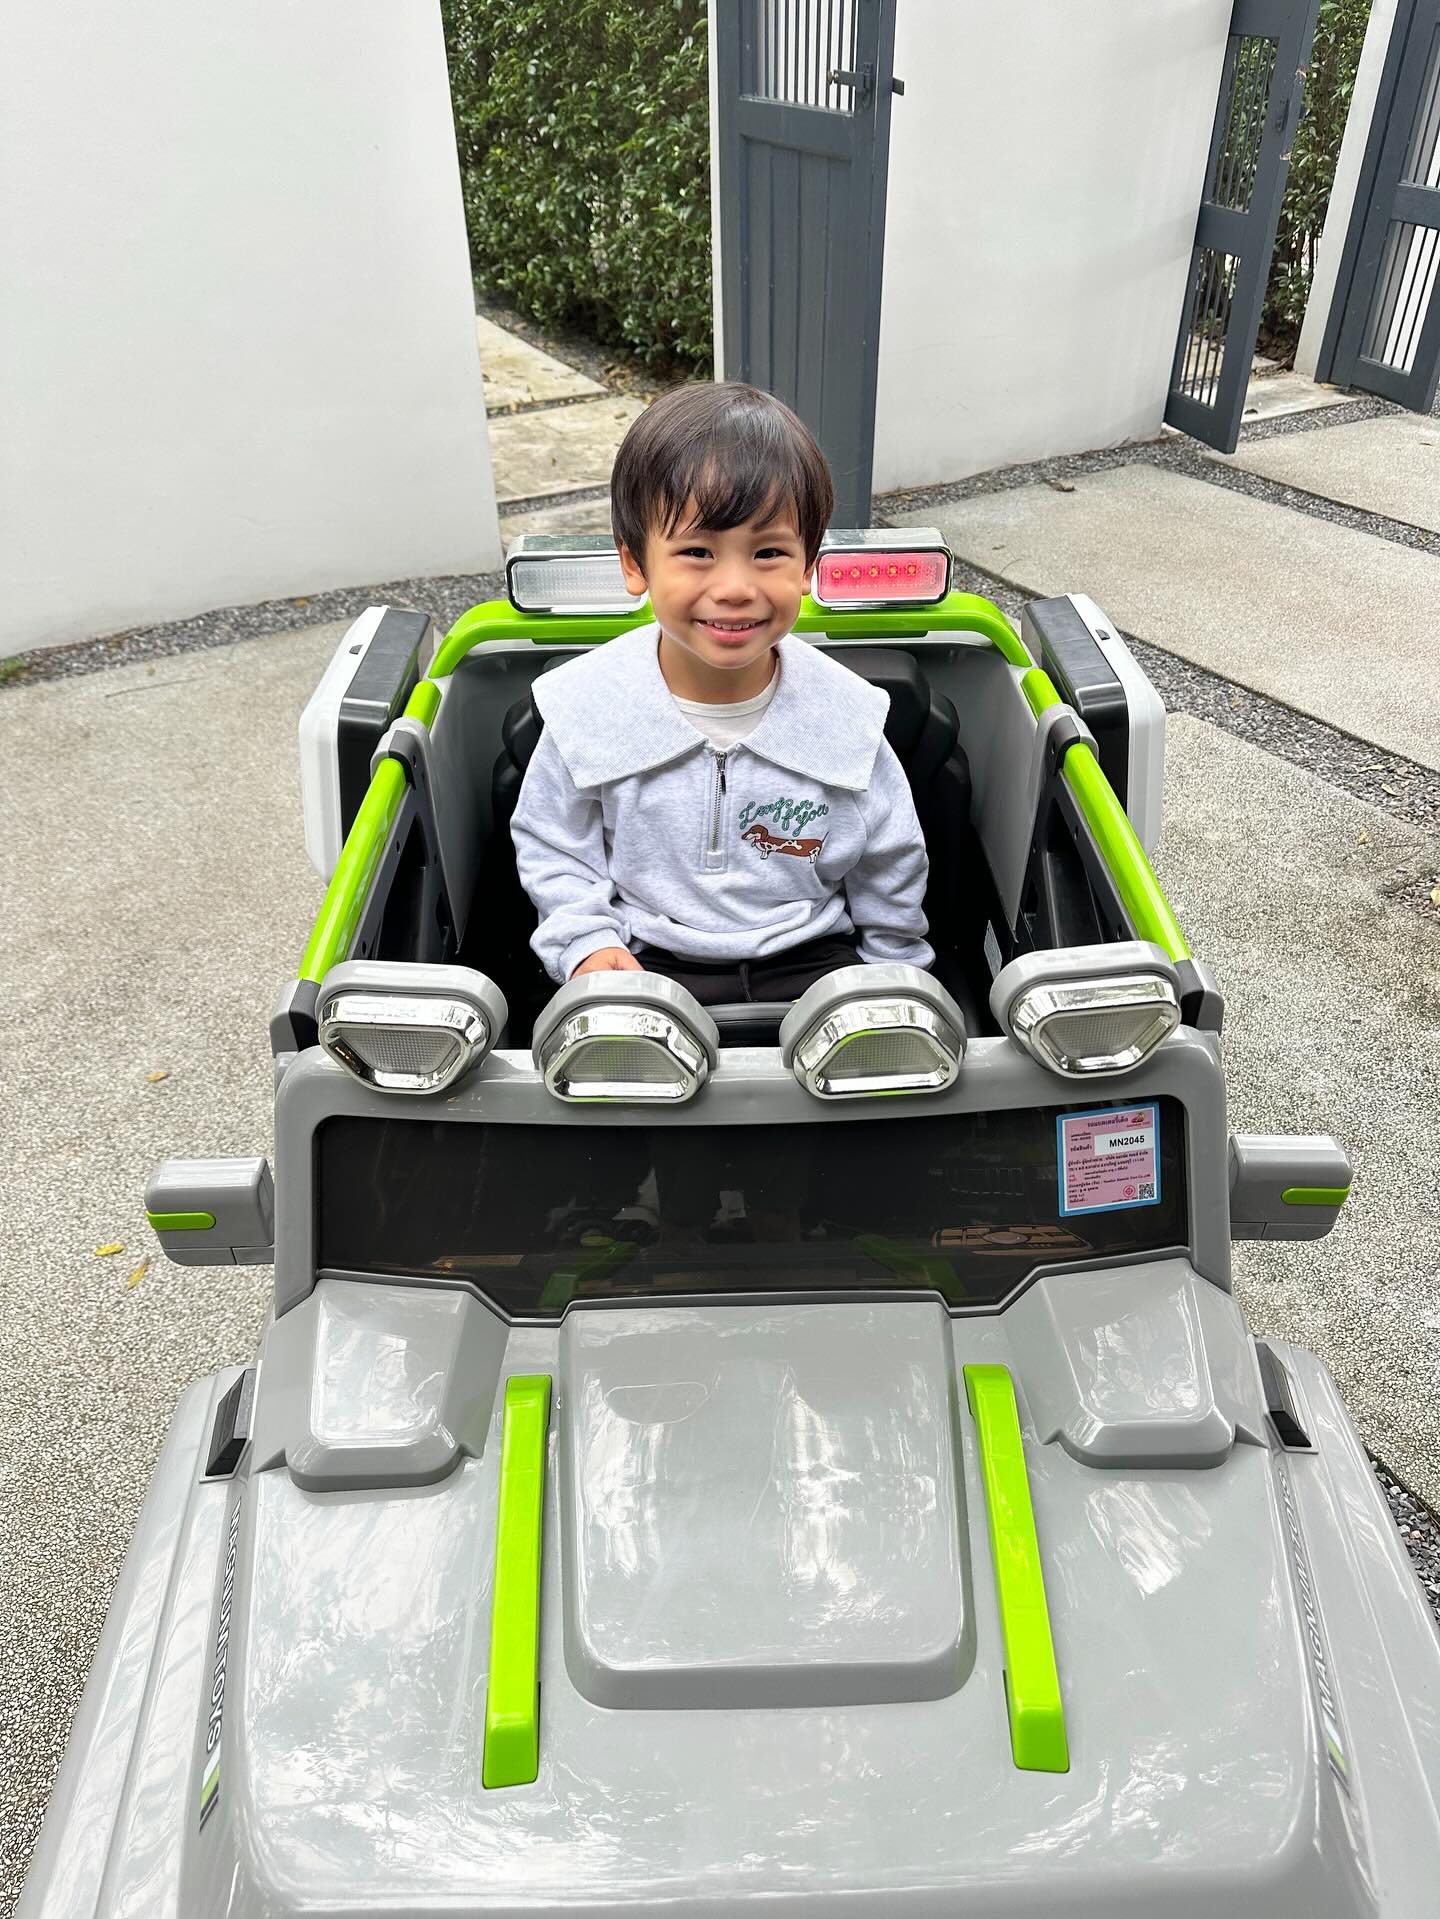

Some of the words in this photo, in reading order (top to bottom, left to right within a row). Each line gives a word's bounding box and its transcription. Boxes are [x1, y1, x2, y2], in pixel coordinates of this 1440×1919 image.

[792, 804, 829, 837] you
[1109, 1135, 1145, 1147] MN2045
[215, 1496, 242, 1658] MAGNUM
[1294, 1550, 1336, 1721] MAGNUM
[206, 1646, 229, 1754] TOYS
